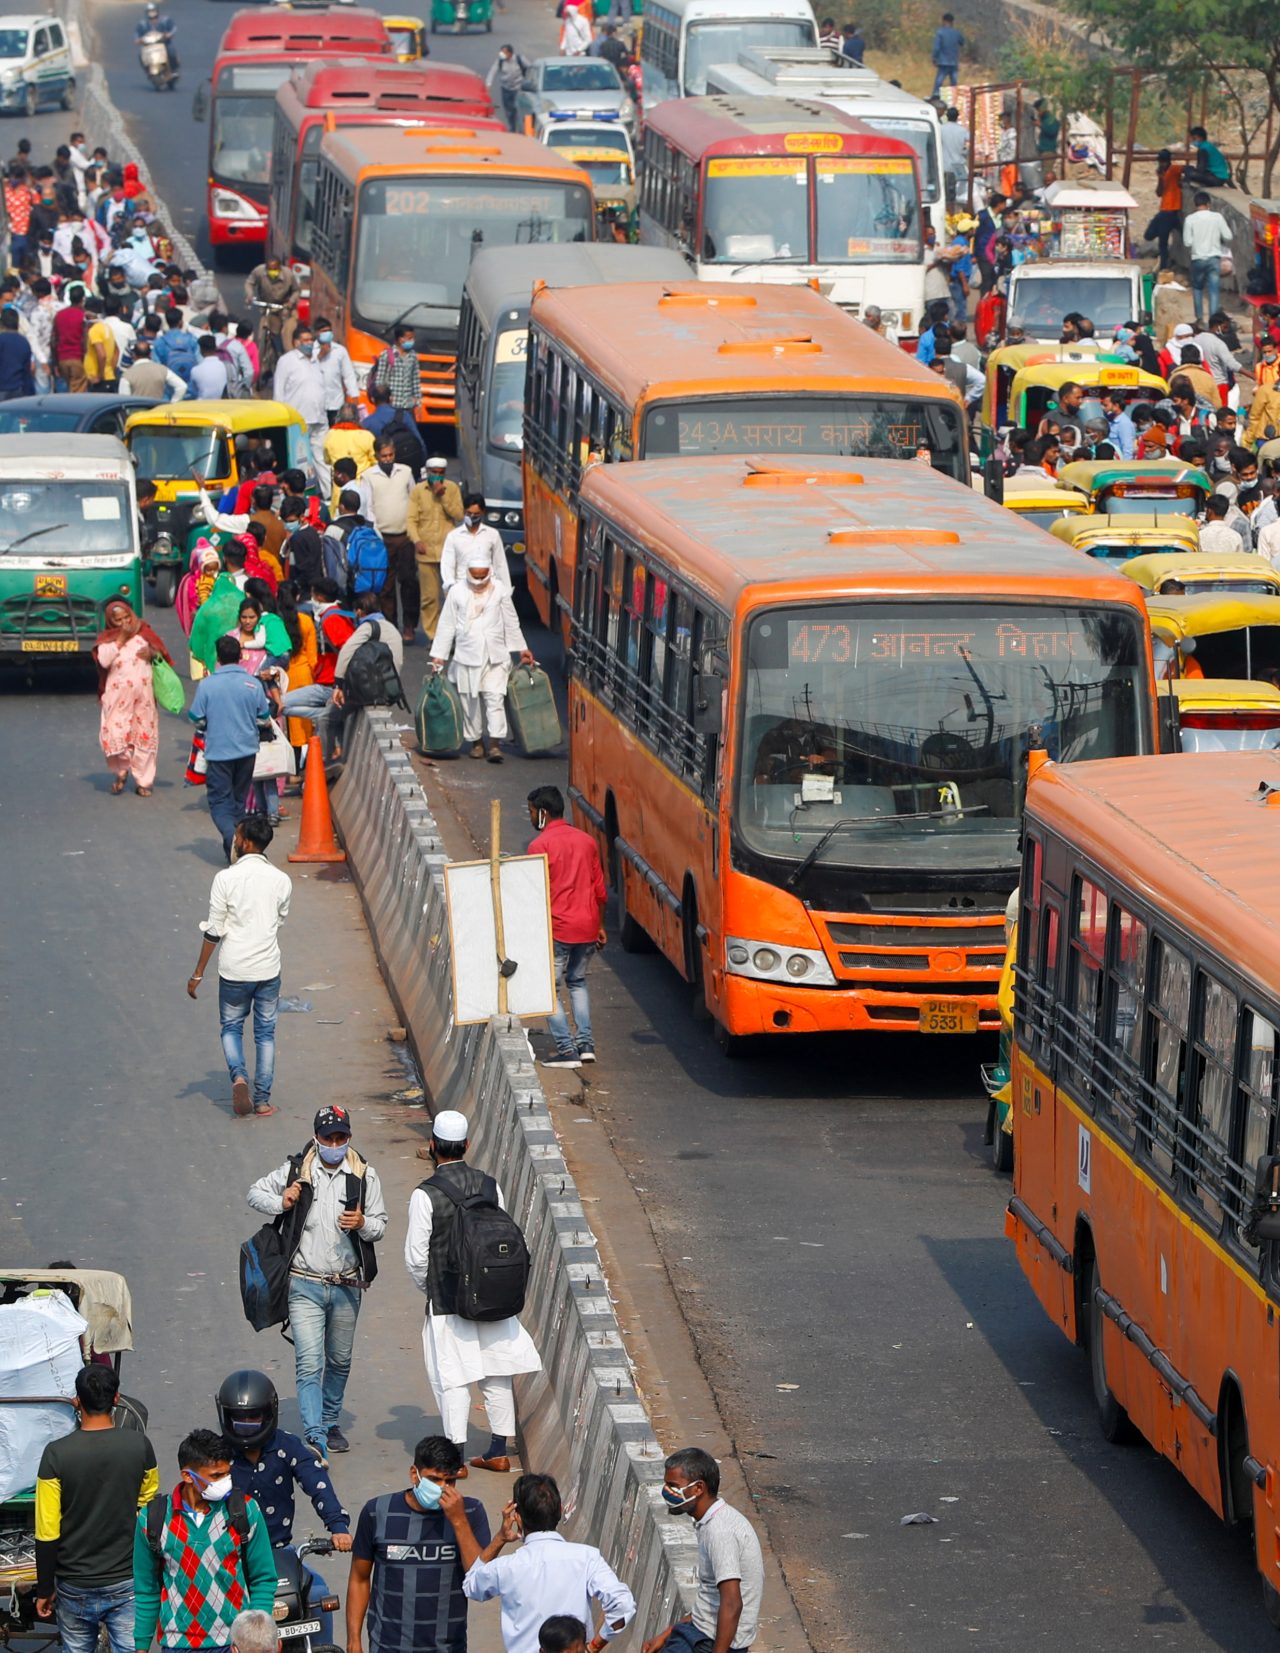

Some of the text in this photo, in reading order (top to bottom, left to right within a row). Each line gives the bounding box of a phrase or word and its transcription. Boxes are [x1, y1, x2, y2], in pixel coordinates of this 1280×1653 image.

[385, 191, 430, 214] 202
[679, 422, 738, 443] 243A
[742, 425, 807, 447] सराय
[792, 624, 1079, 662] 473 आनन्द विहार
[929, 1015, 964, 1031] 5331
[403, 1545, 456, 1561] AUS
